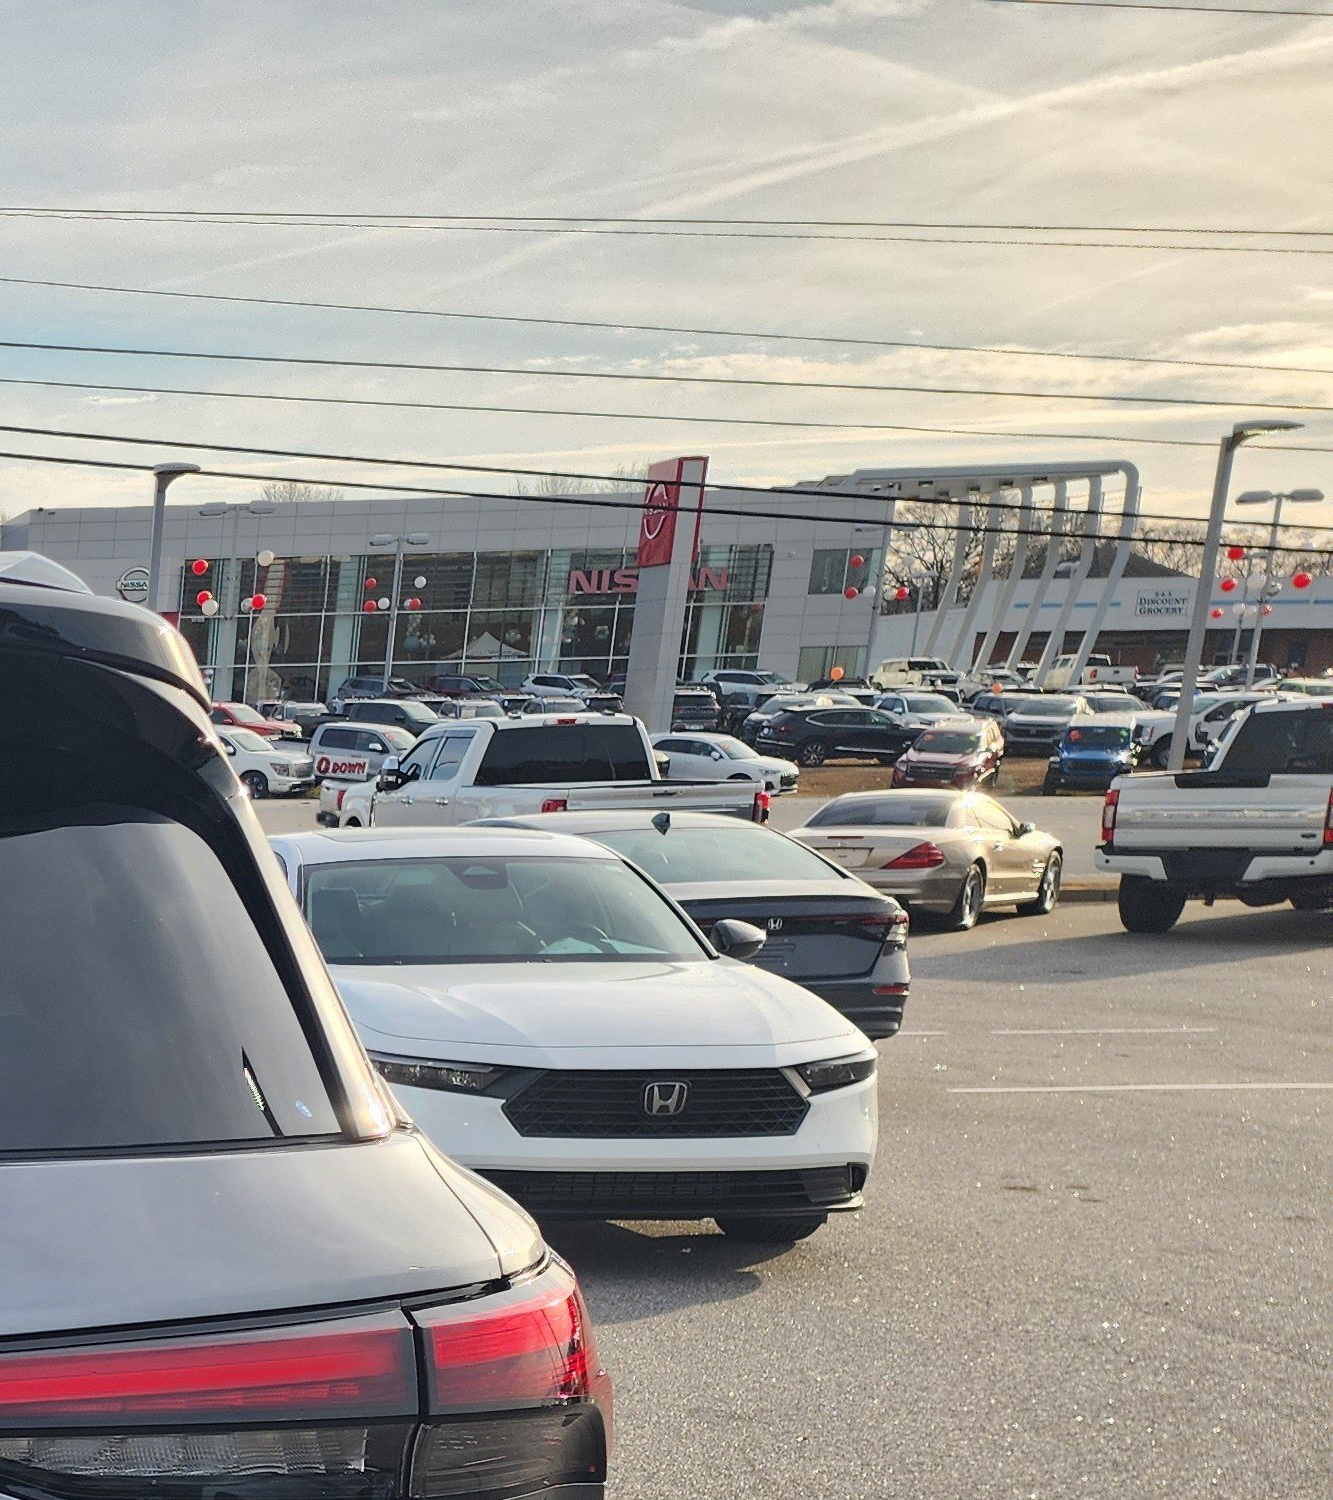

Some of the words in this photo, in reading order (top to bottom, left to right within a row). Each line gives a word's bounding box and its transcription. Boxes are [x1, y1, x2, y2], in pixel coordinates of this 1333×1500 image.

[568, 565, 729, 595] NISN
[1139, 597, 1186, 605] DISCOUNT
[1139, 606, 1182, 615] GROCERY
[332, 761, 367, 775] DOWN
